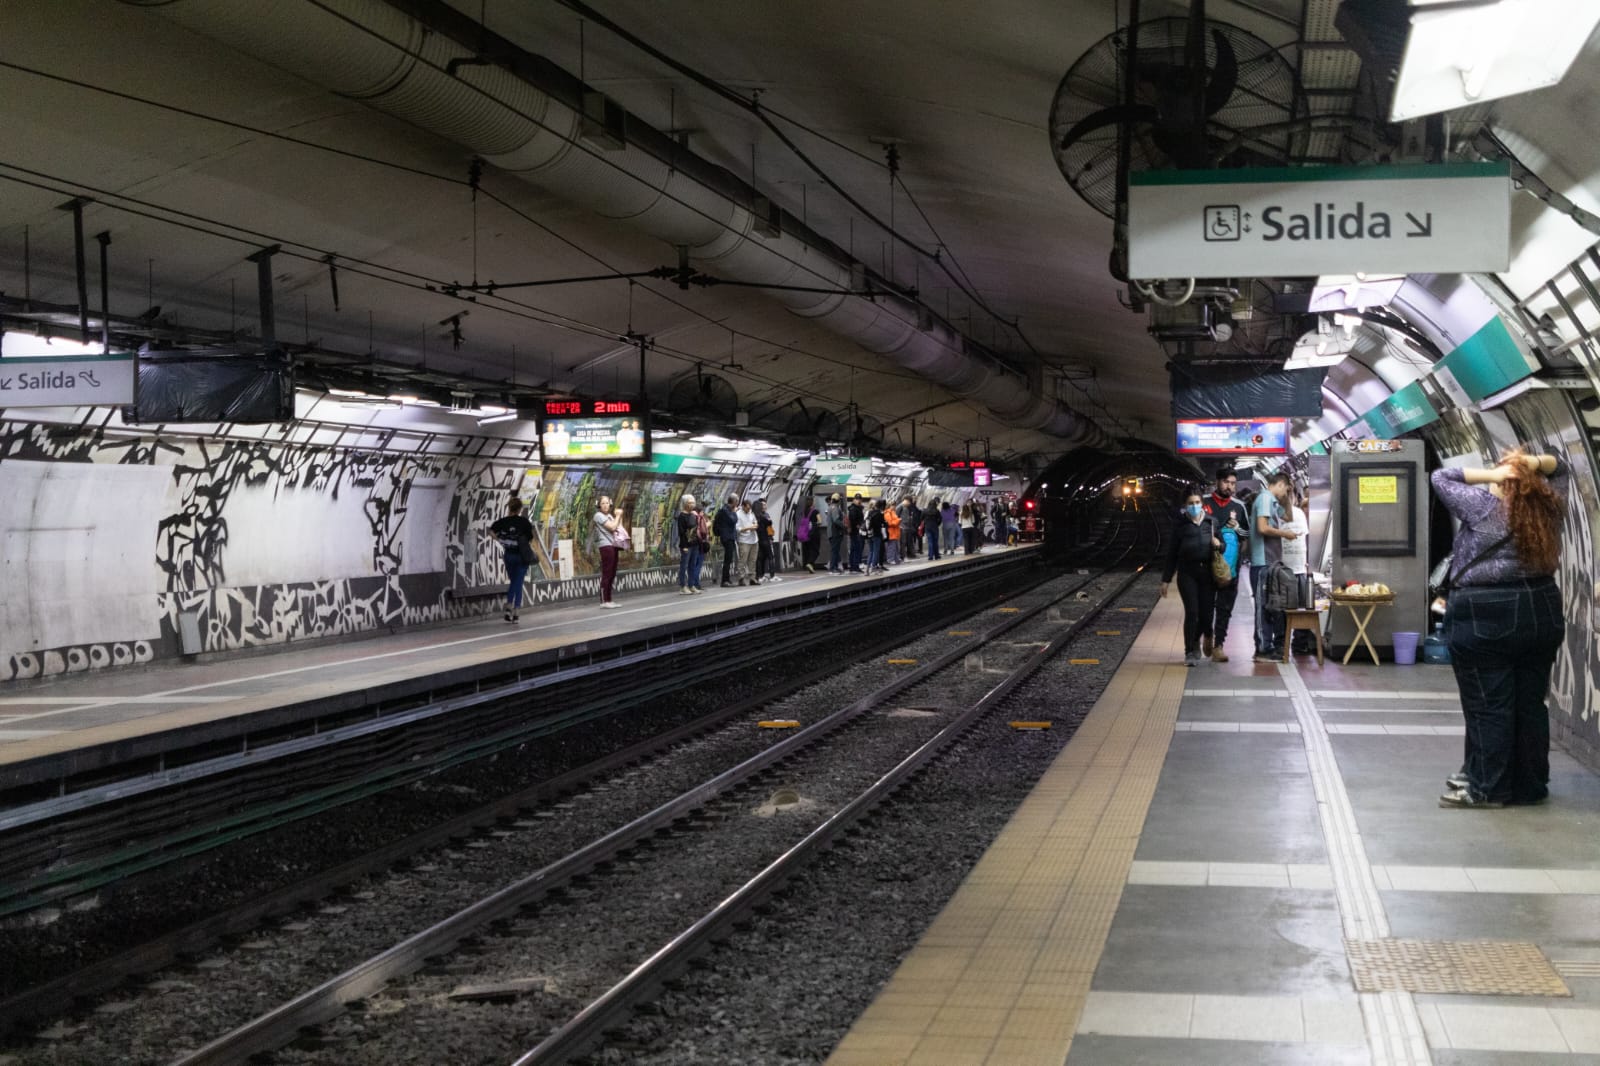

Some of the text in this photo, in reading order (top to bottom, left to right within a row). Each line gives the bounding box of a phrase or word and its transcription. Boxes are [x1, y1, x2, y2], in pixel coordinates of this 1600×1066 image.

[1261, 202, 1392, 242] Salida
[18, 370, 76, 390] Salida
[594, 401, 630, 413] 2 min
